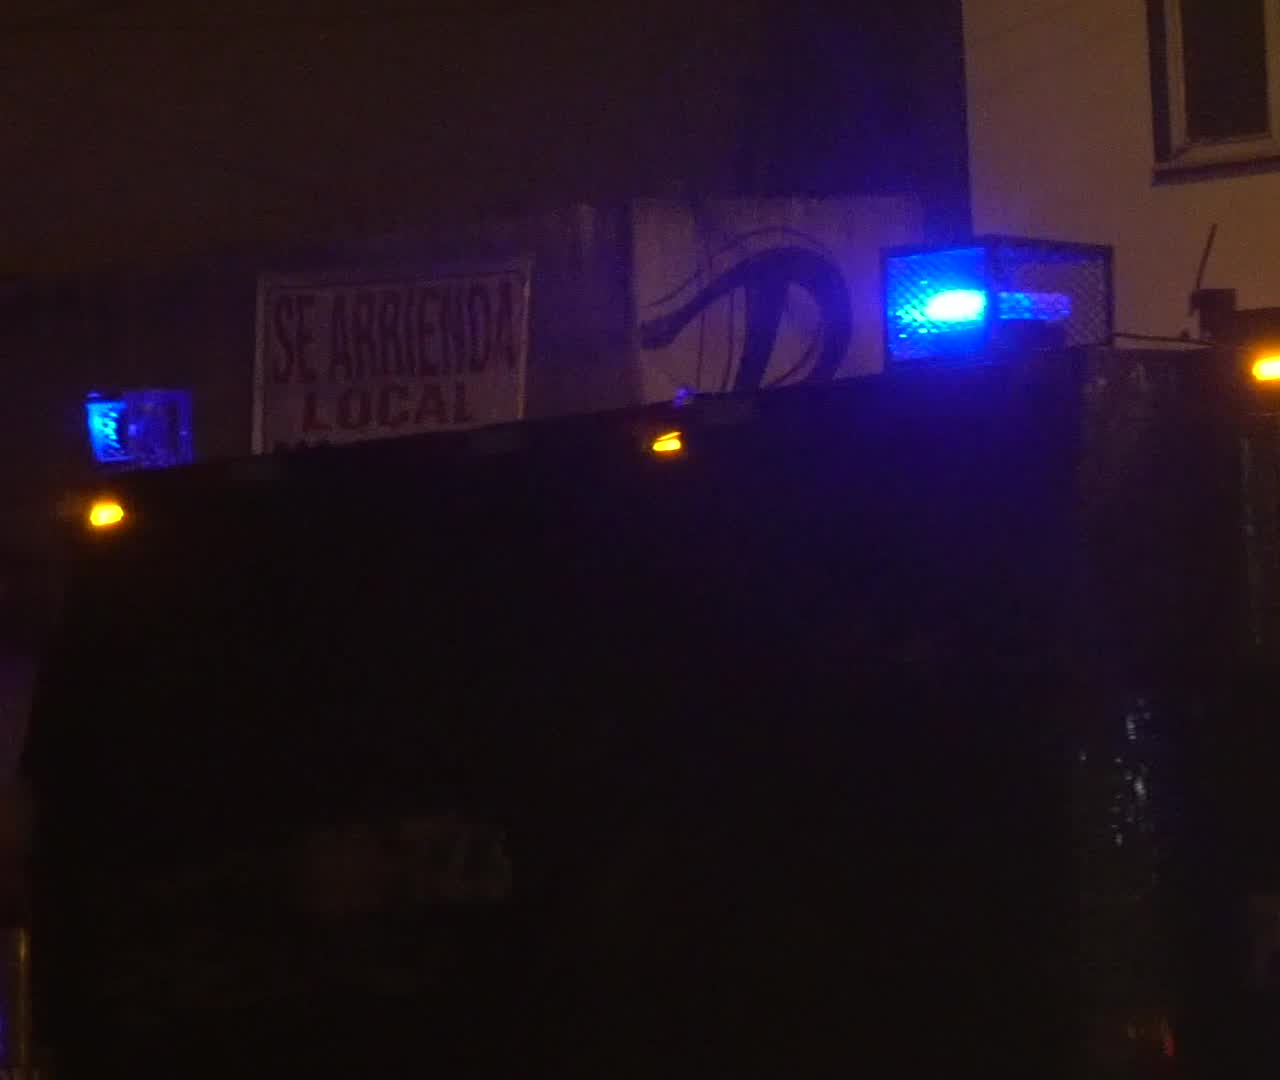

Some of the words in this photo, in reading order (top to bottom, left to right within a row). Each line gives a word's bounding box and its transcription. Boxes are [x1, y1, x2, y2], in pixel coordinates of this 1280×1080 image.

[272, 293, 318, 384] SE
[330, 279, 518, 383] ARRIENDA
[302, 382, 473, 433] LOCAL
